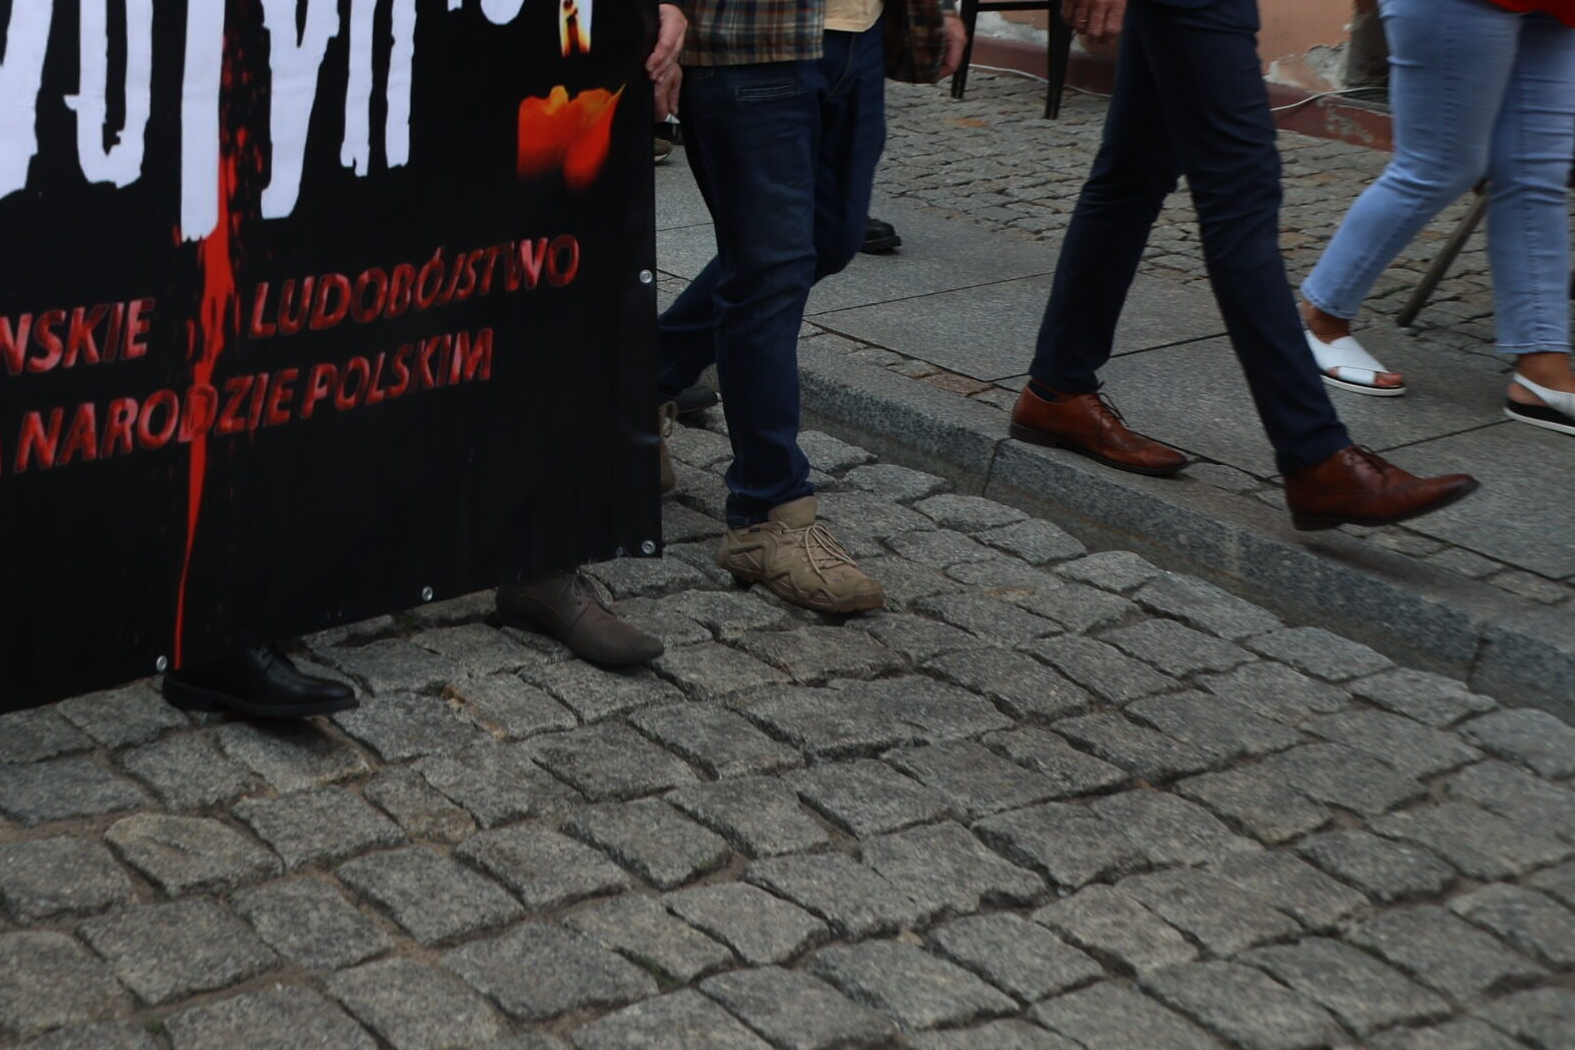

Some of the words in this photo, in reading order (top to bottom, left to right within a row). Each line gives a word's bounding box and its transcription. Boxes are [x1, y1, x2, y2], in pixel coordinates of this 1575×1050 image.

[249, 234, 580, 339] LUDOBÓJSTWO
[14, 367, 299, 473] NARODZIE
[300, 327, 494, 419] POLSKIM
